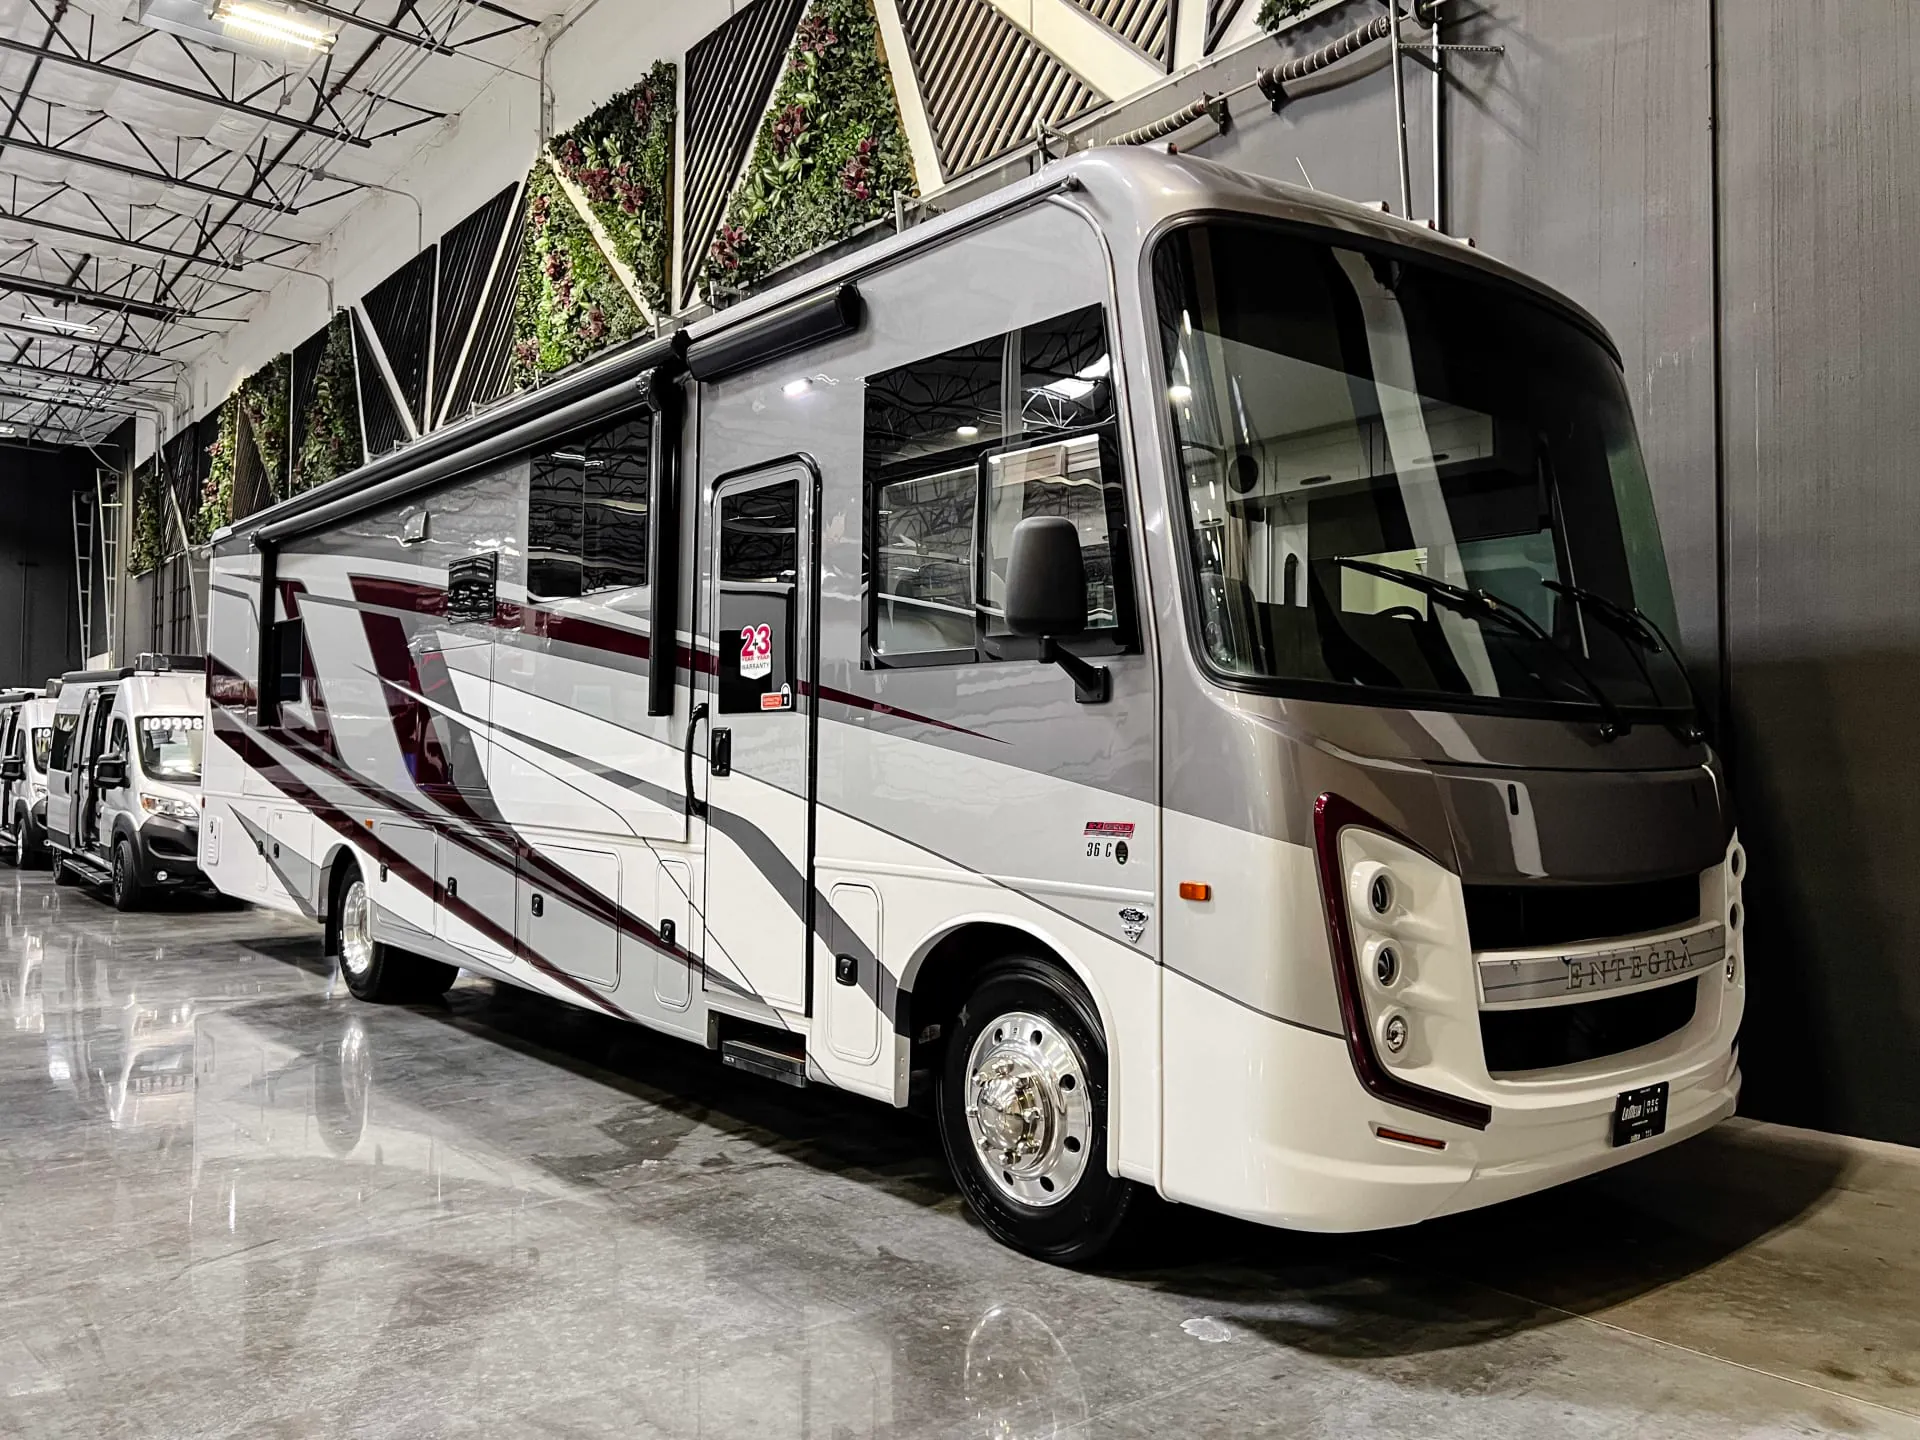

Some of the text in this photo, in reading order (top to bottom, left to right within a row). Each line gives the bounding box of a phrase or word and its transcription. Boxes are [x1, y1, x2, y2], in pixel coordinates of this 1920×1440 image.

[742, 662, 769, 670] WARRANTY
[143, 717, 203, 731] 109998
[1086, 842, 1100, 857] 36
[1105, 842, 1112, 858] C
[1566, 946, 1693, 990] ENTEGRA
